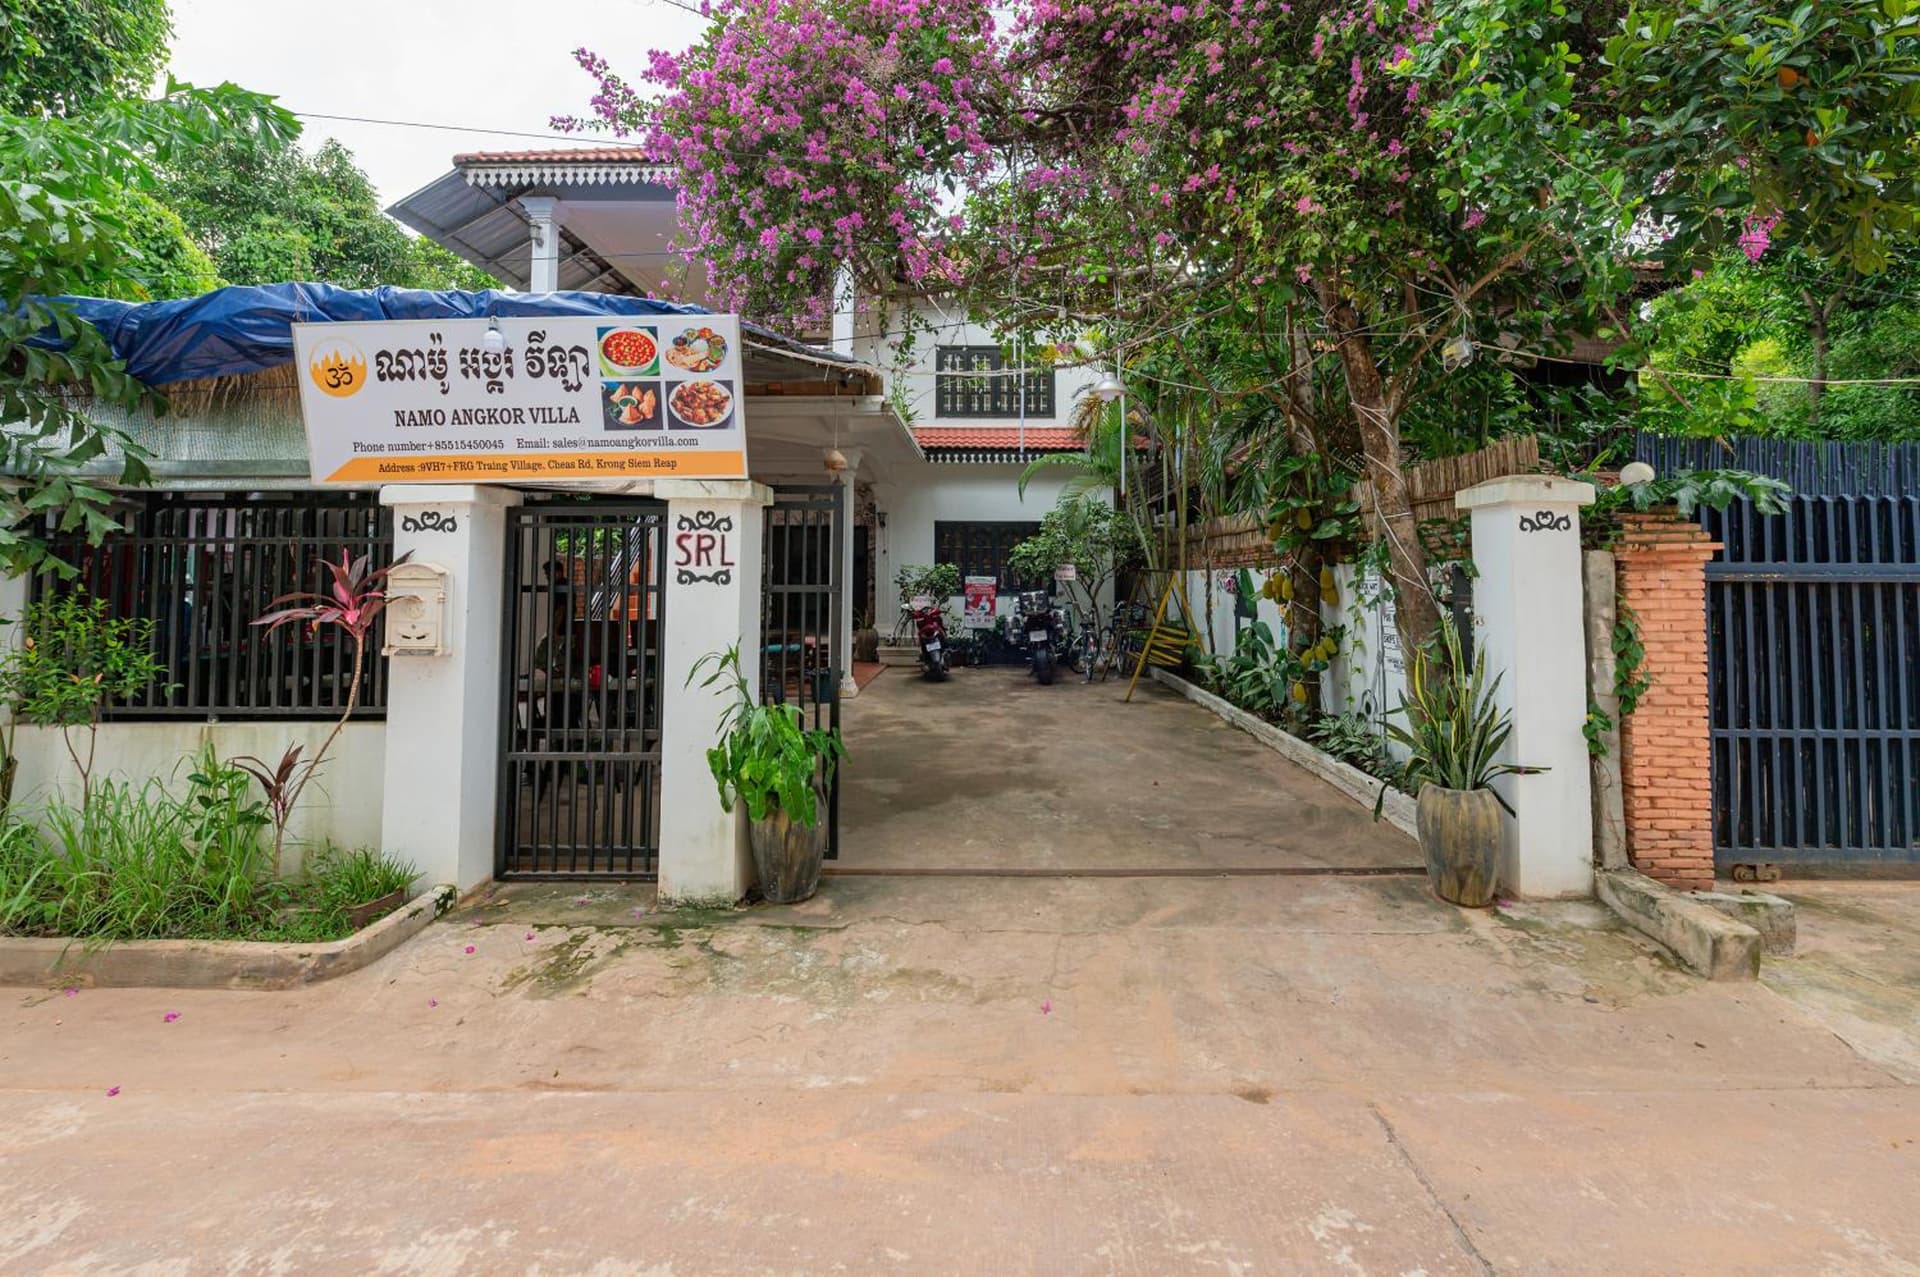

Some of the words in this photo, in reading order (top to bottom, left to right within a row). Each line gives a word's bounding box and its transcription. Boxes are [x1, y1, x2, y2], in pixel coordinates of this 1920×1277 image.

[394, 409, 446, 427] NAMO
[451, 407, 525, 426] ANGKOR
[528, 406, 581, 425] VILLA
[352, 440, 385, 452] Phone
[388, 438, 505, 451] number+85515450045
[516, 437, 550, 449] Email:
[553, 434, 699, 450] sales@namoangkorvilla.com
[378, 463, 416, 473] Address
[476, 460, 509, 472] Traing
[547, 459, 575, 470] Cheas
[597, 458, 625, 471] Krong
[628, 457, 651, 469] Siem
[654, 456, 677, 470] Reap
[675, 533, 735, 566] SRL
